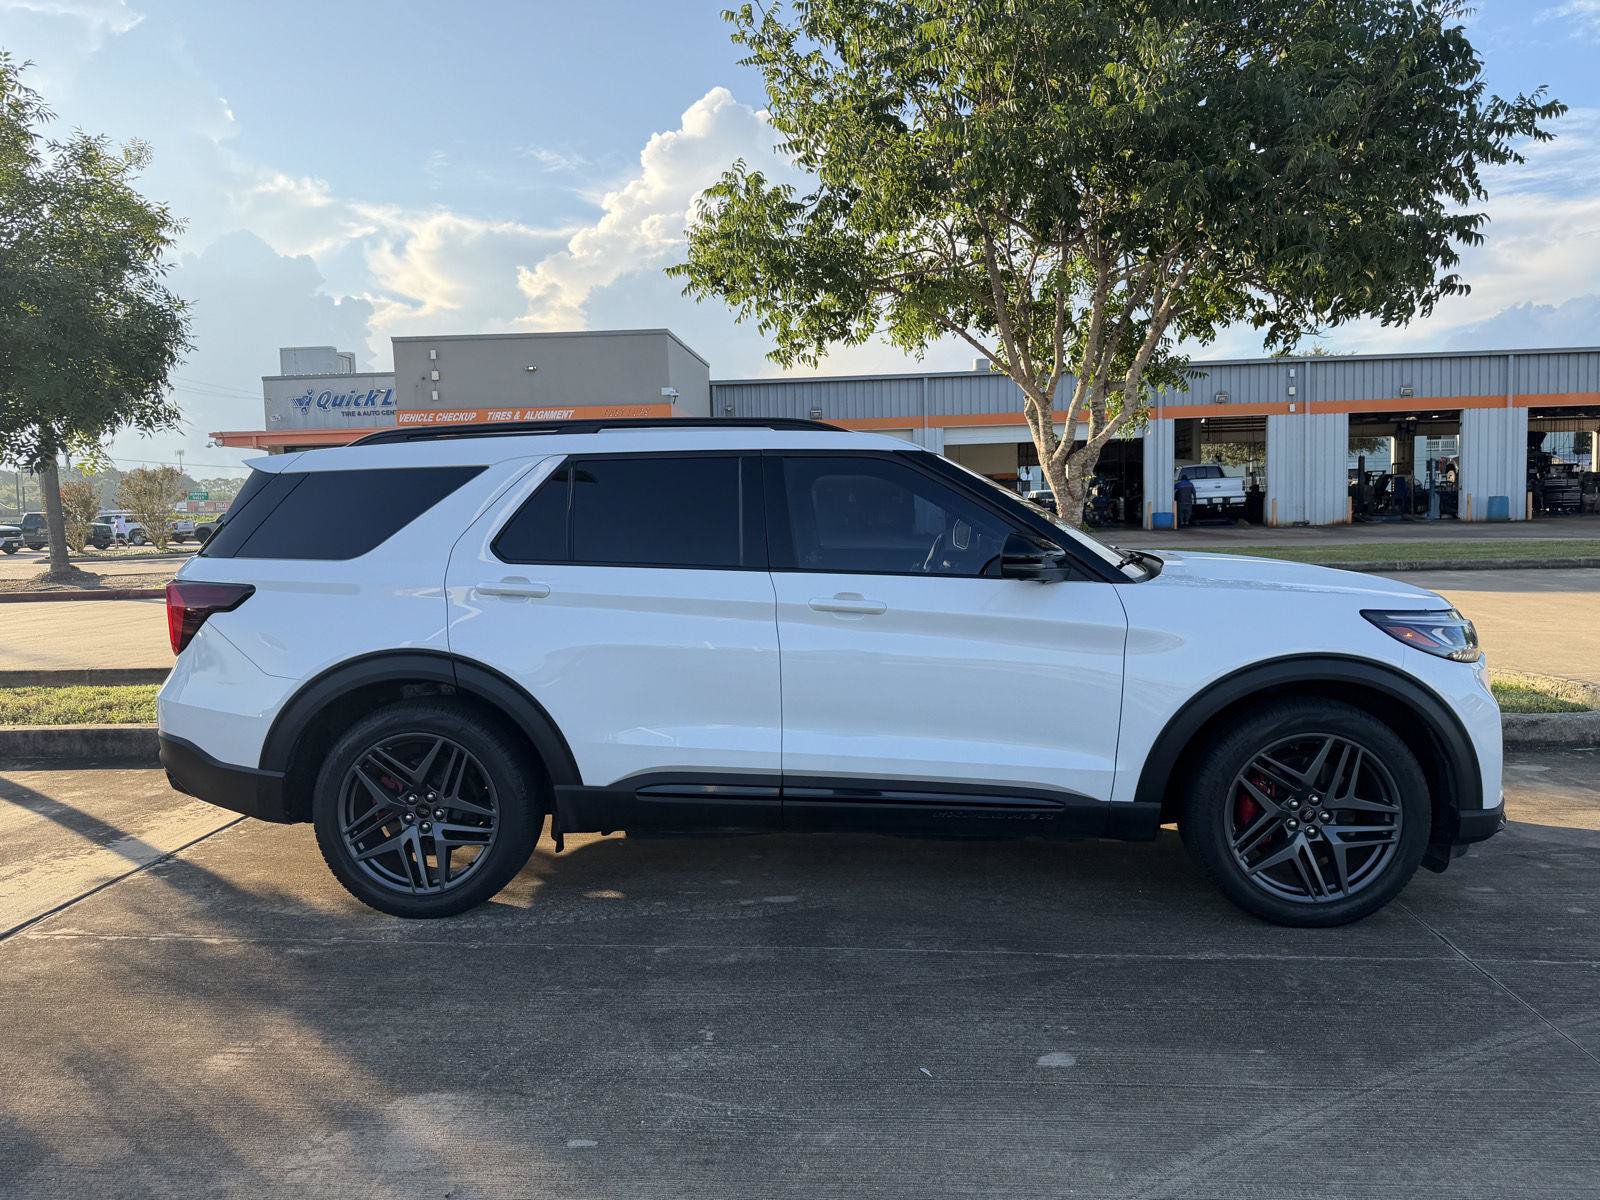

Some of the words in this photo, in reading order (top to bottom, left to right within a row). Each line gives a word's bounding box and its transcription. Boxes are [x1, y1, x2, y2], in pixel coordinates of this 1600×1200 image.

[316, 389, 379, 411] Quick
[381, 388, 397, 406] L
[399, 413, 434, 422] VEHICLE
[435, 411, 477, 421] CHECKUP
[487, 411, 512, 420] TIRES
[513, 411, 520, 419] &
[525, 410, 575, 419] ALIGNMENT
